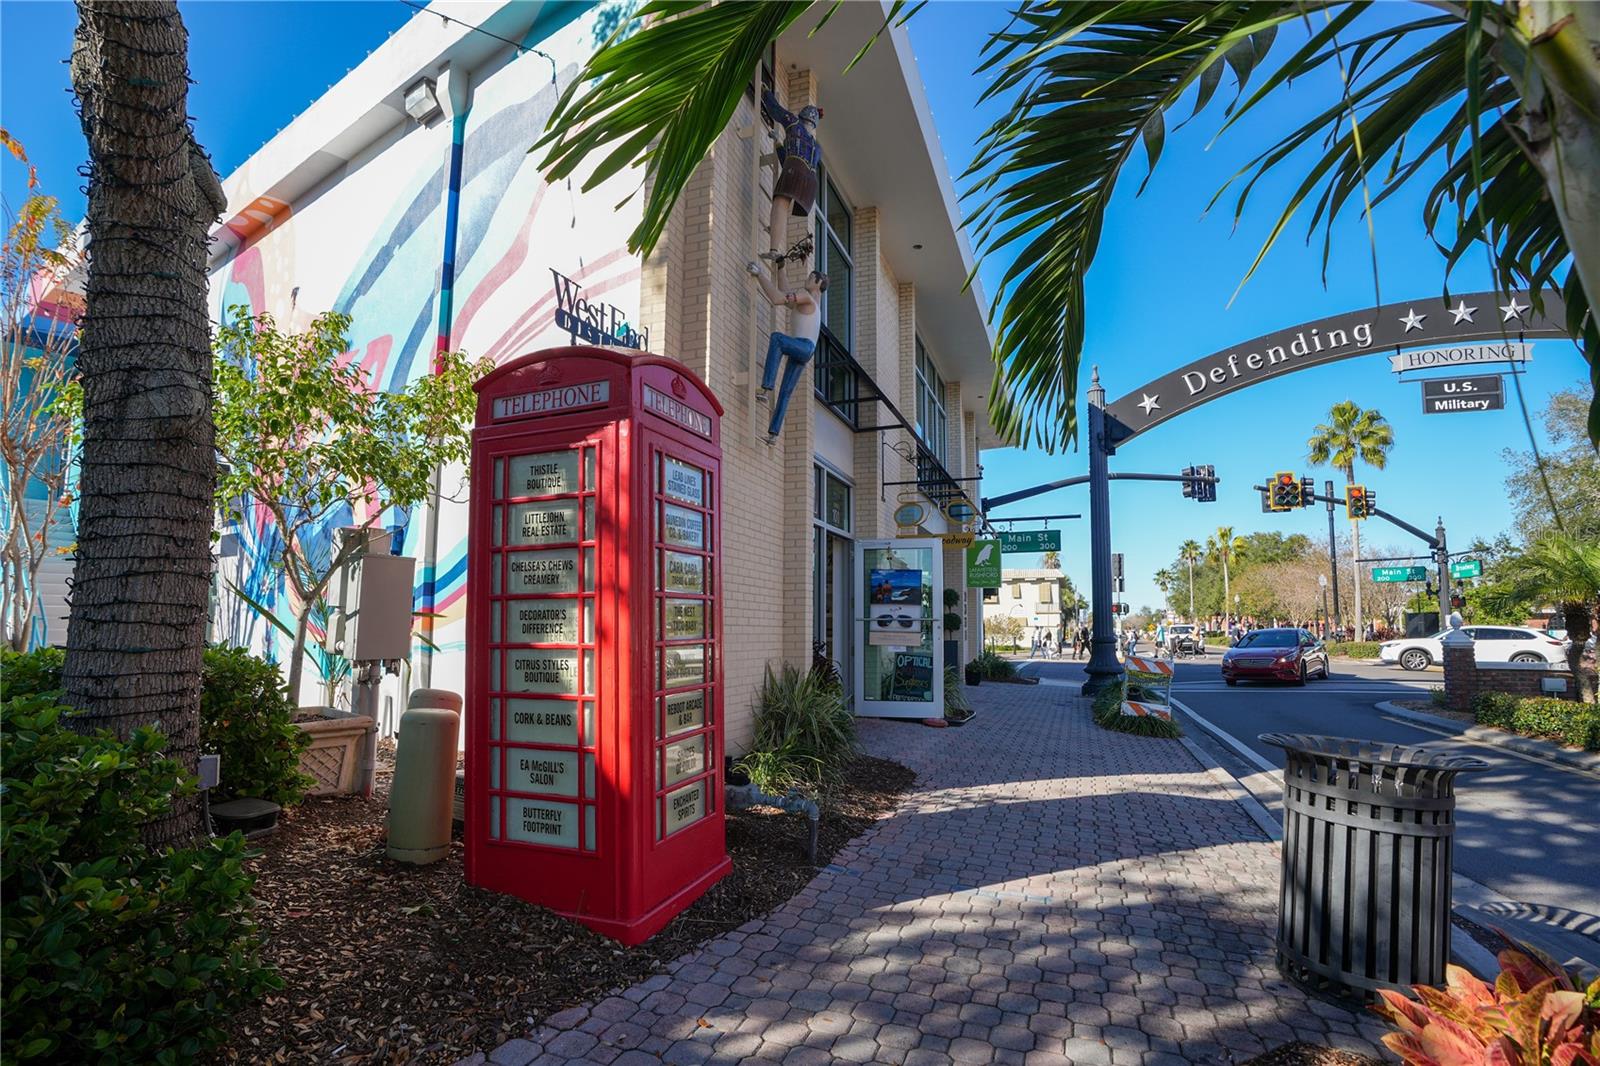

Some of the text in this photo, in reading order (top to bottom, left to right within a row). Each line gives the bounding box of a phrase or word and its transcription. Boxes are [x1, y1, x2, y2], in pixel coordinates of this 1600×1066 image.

[549, 267, 649, 352] West End
[1182, 322, 1373, 396] Defending
[1408, 344, 1516, 366] HONORING
[1443, 381, 1478, 393] U.S.
[501, 383, 602, 416] TELEPHONE
[1434, 399, 1490, 411] Military
[529, 463, 558, 475] THISTLE
[526, 476, 562, 490] BOUTIQUE
[524, 511, 565, 525] LITTLEJOHN
[522, 523, 567, 537] REAL ESTATE
[1008, 533, 1048, 543] Main St
[511, 559, 574, 573] CHELSEA'S CHEWS
[523, 573, 560, 585] CREAMERY
[519, 609, 567, 621] DECORATOR'S
[522, 623, 563, 634] DIFFERENCE
[514, 659, 569, 671] CITRUS STYLES
[897, 655, 933, 668] OPTICAL
[524, 671, 560, 683] BOUTIQUE
[667, 698, 702, 715] REBOOT ARCADE
[514, 712, 572, 726] CORK & BEANS
[683, 712, 692, 724] BAR
[520, 759, 565, 774] EA McGILL'S
[529, 773, 554, 786] SALON
[673, 789, 699, 810] ENCHANTED
[522, 807, 562, 821] BUTTERFLY
[677, 803, 695, 821] SPIRITS
[522, 821, 562, 835] FOOTPRINT
